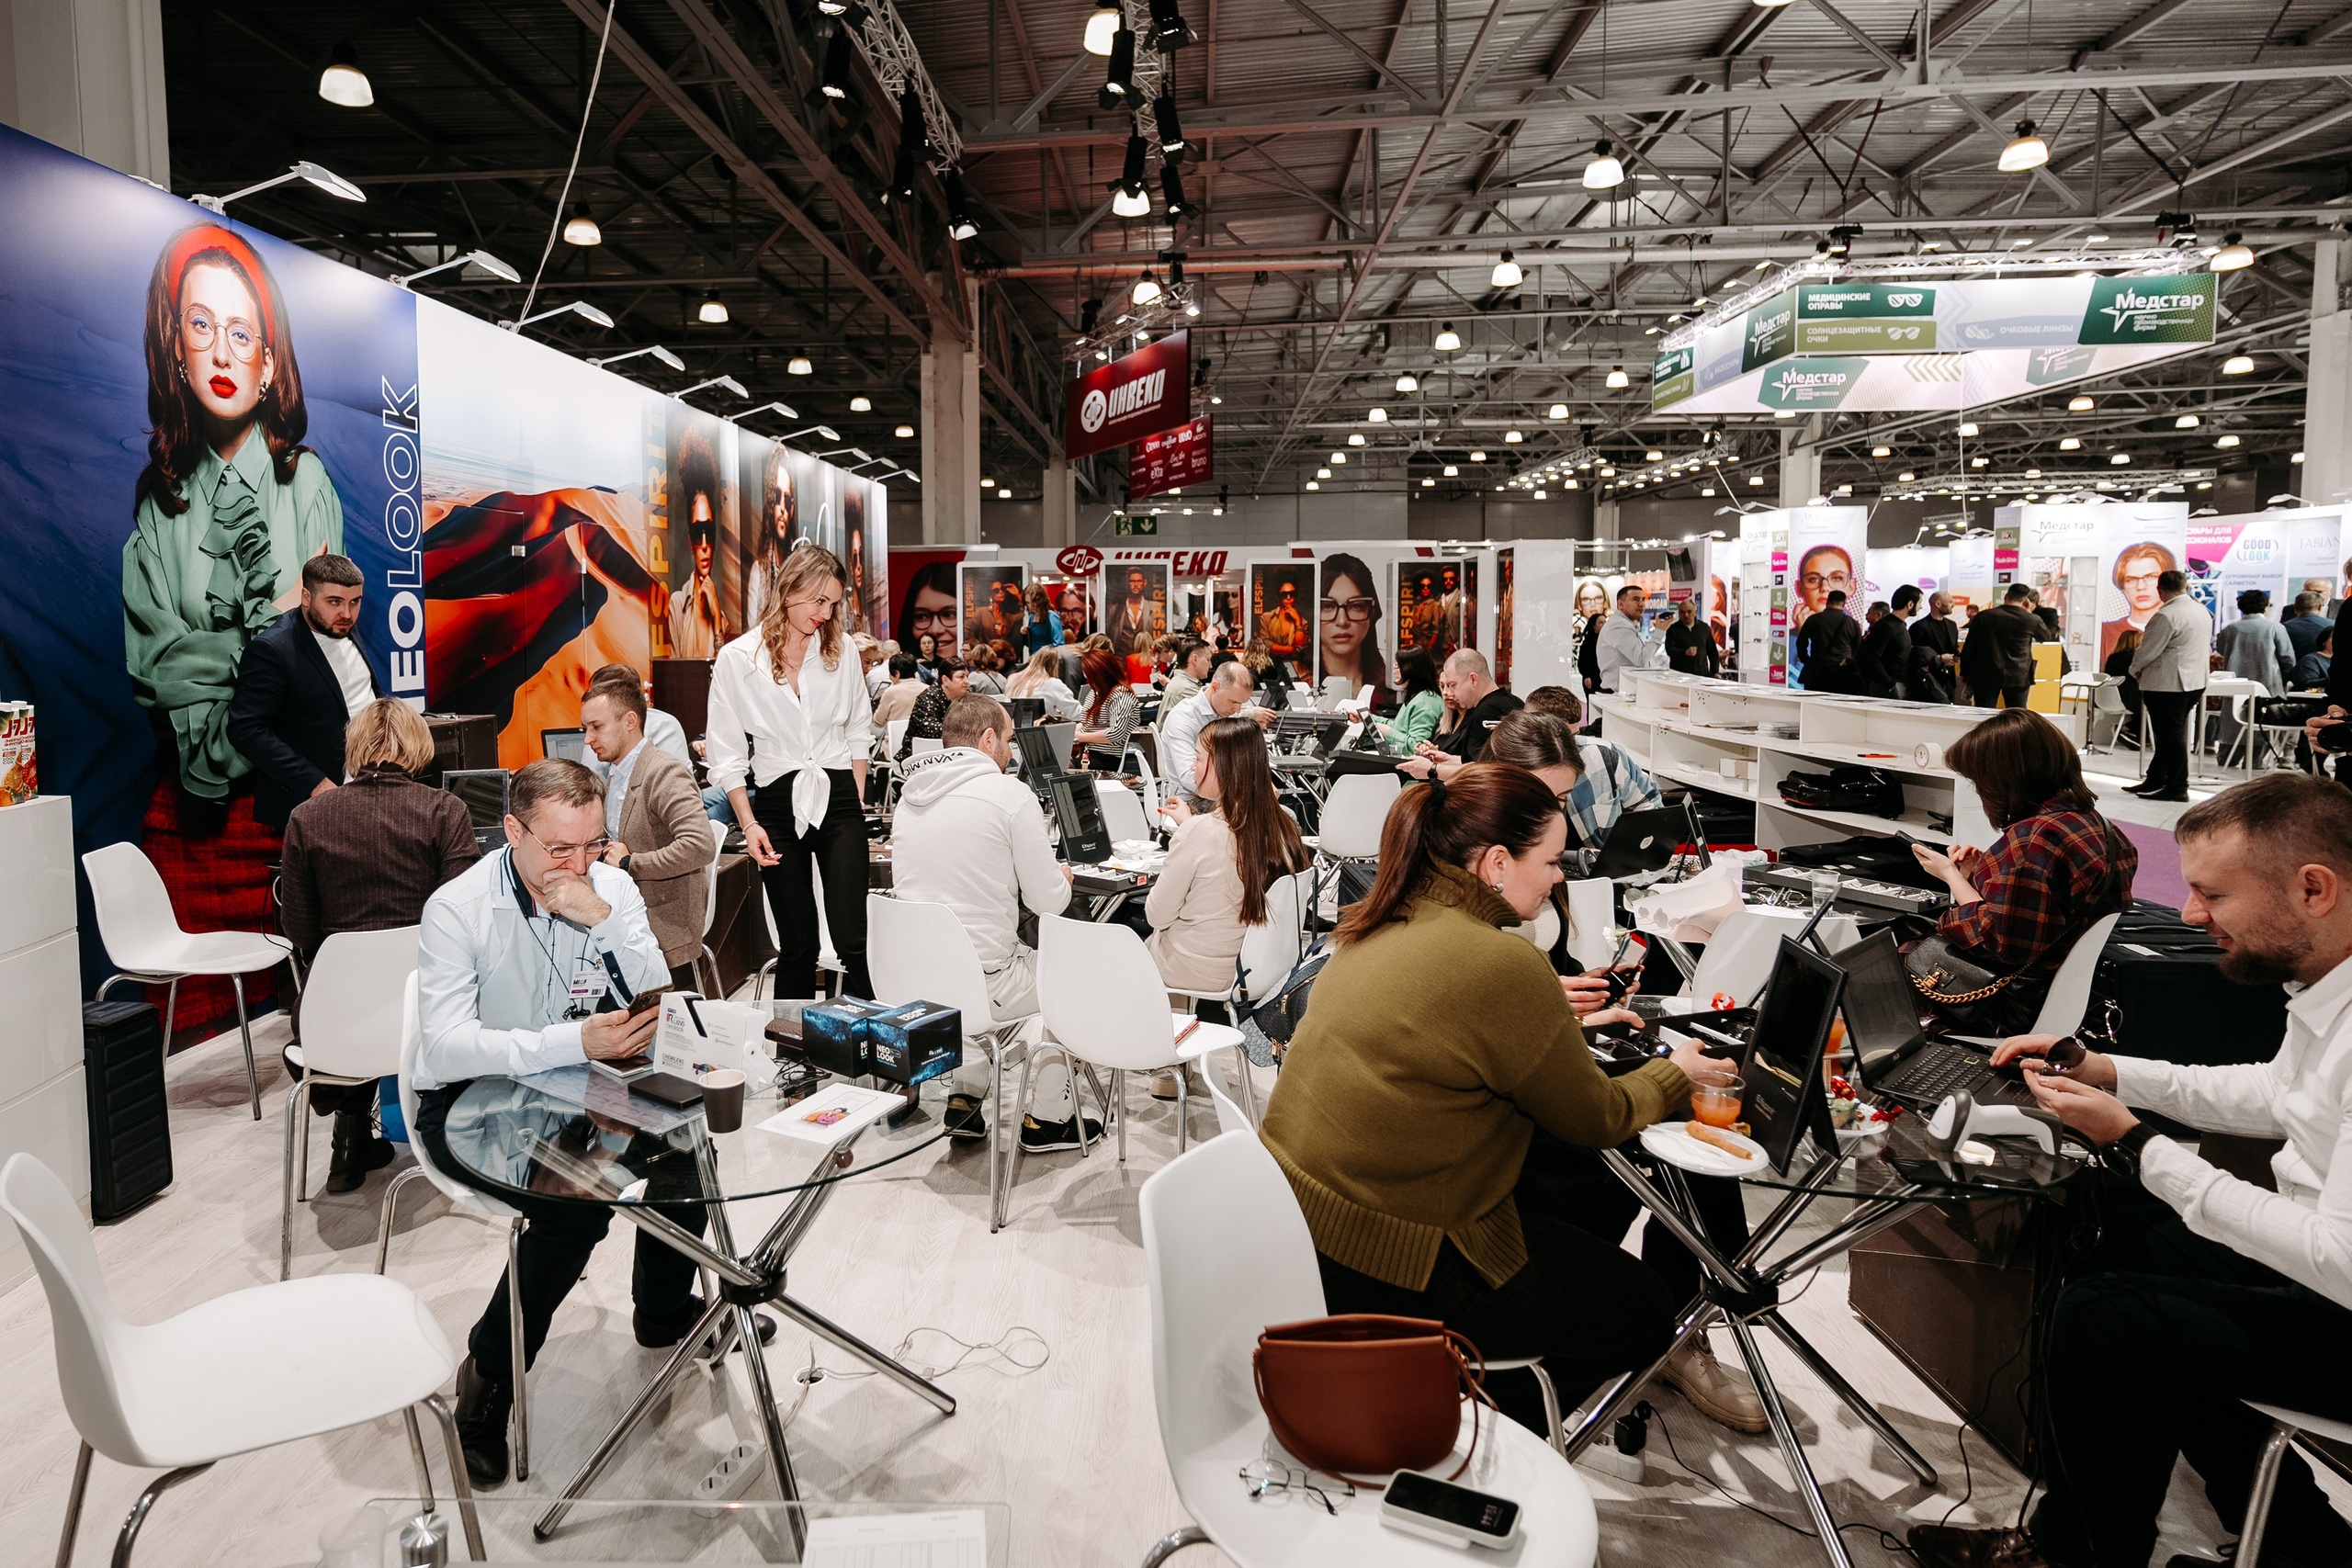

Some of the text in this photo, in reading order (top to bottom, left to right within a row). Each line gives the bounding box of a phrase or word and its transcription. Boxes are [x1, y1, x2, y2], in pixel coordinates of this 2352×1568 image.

[1808, 293, 1871, 302] МЕДИЦИНСКИЕ
[2115, 292, 2205, 310] Медстар
[1807, 301, 1843, 310] ОПРАВЫ
[1755, 310, 1791, 336] Медстар
[2000, 324, 2074, 333] ОЧКОВЫЕ ЛИНЗЫ
[1807, 326, 1882, 334] СОЛНЦЕЗАЩИТНЫЕ
[1782, 371, 1847, 386] Медстар
[1108, 368, 1166, 418] ИНВЕКО
[2041, 521, 2094, 532] Медстар
[2214, 526, 2232, 535] ДЛЯ
[381, 375, 424, 715] EOLOOK
[2243, 539, 2271, 549] GOOD
[2243, 551, 2269, 561] LOOK
[876, 1043, 890, 1055] NEO
[876, 1052, 895, 1064] LOOK
